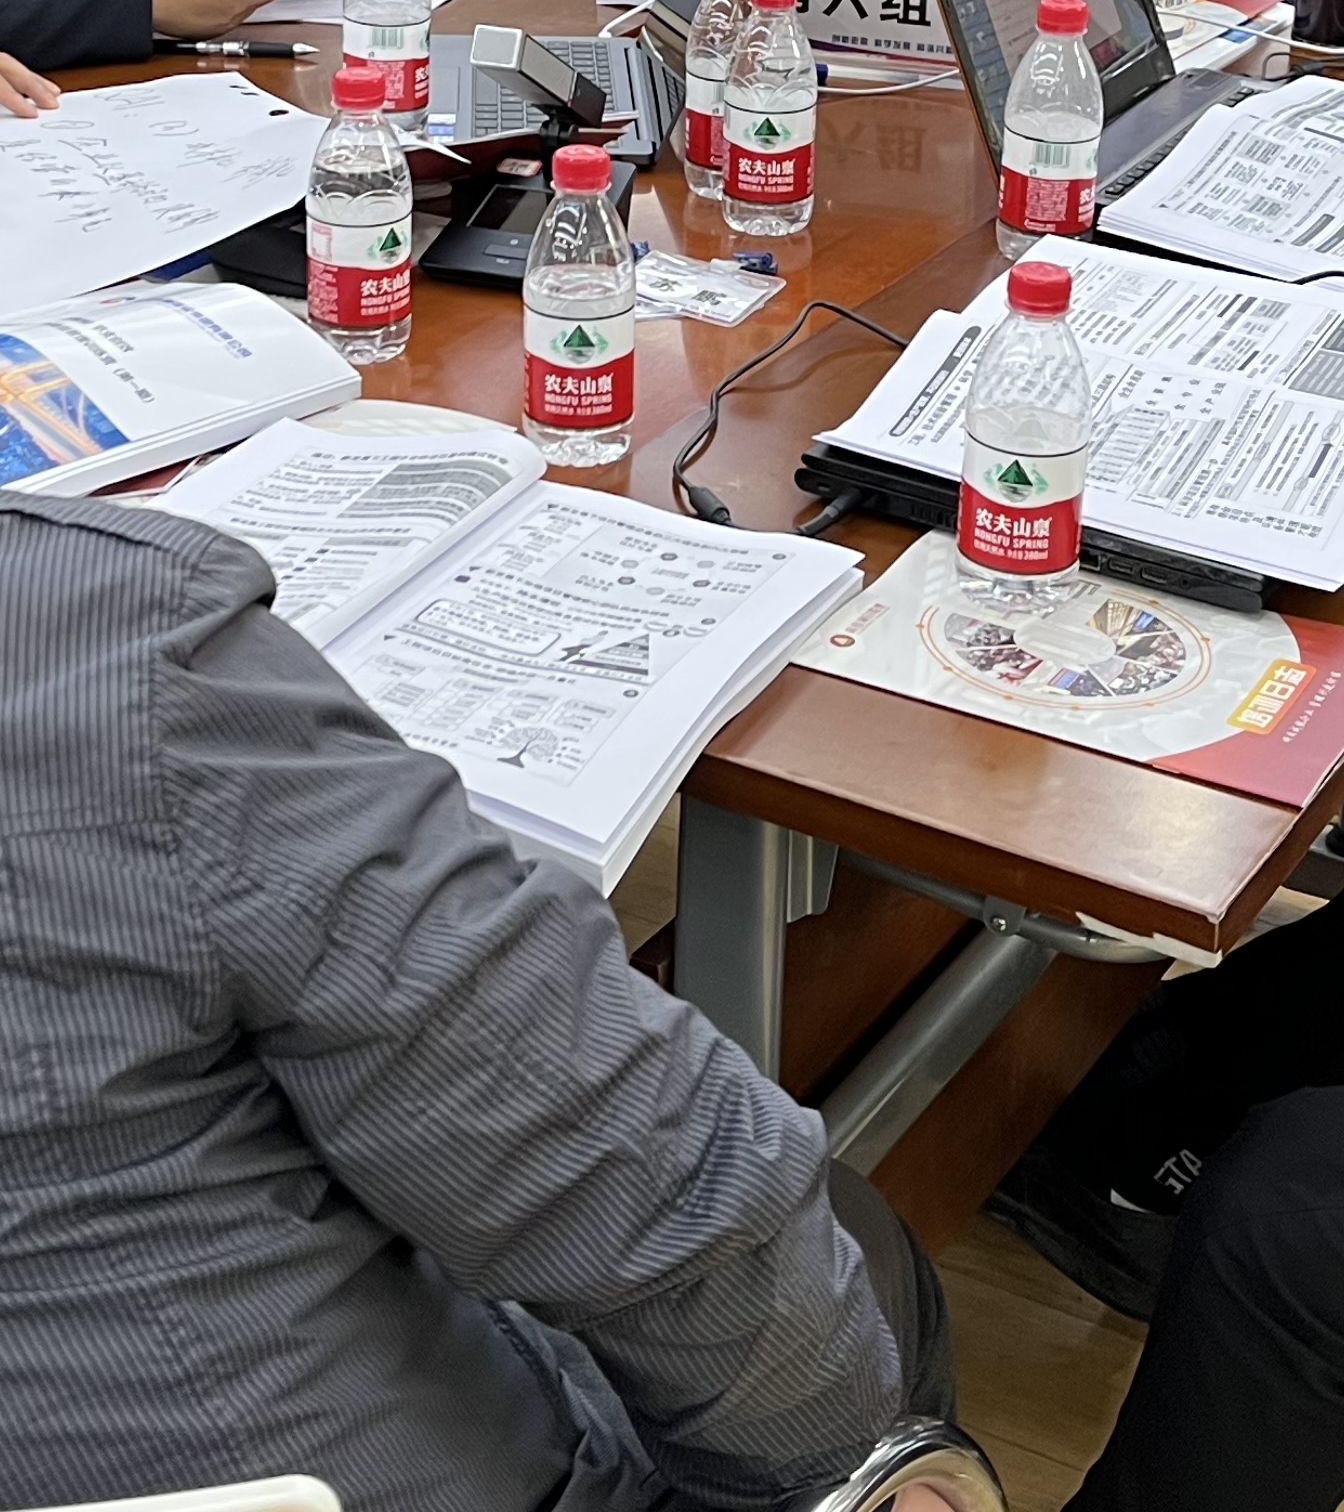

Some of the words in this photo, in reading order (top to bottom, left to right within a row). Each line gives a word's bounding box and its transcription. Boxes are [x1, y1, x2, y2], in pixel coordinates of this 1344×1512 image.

[738, 157, 796, 176] 农夫山泉
[544, 371, 614, 396] 农夫山泉
[975, 507, 1053, 538] 农夫山泉
[974, 526, 1011, 548] NONGFU
[1012, 537, 1049, 549] SPRING
